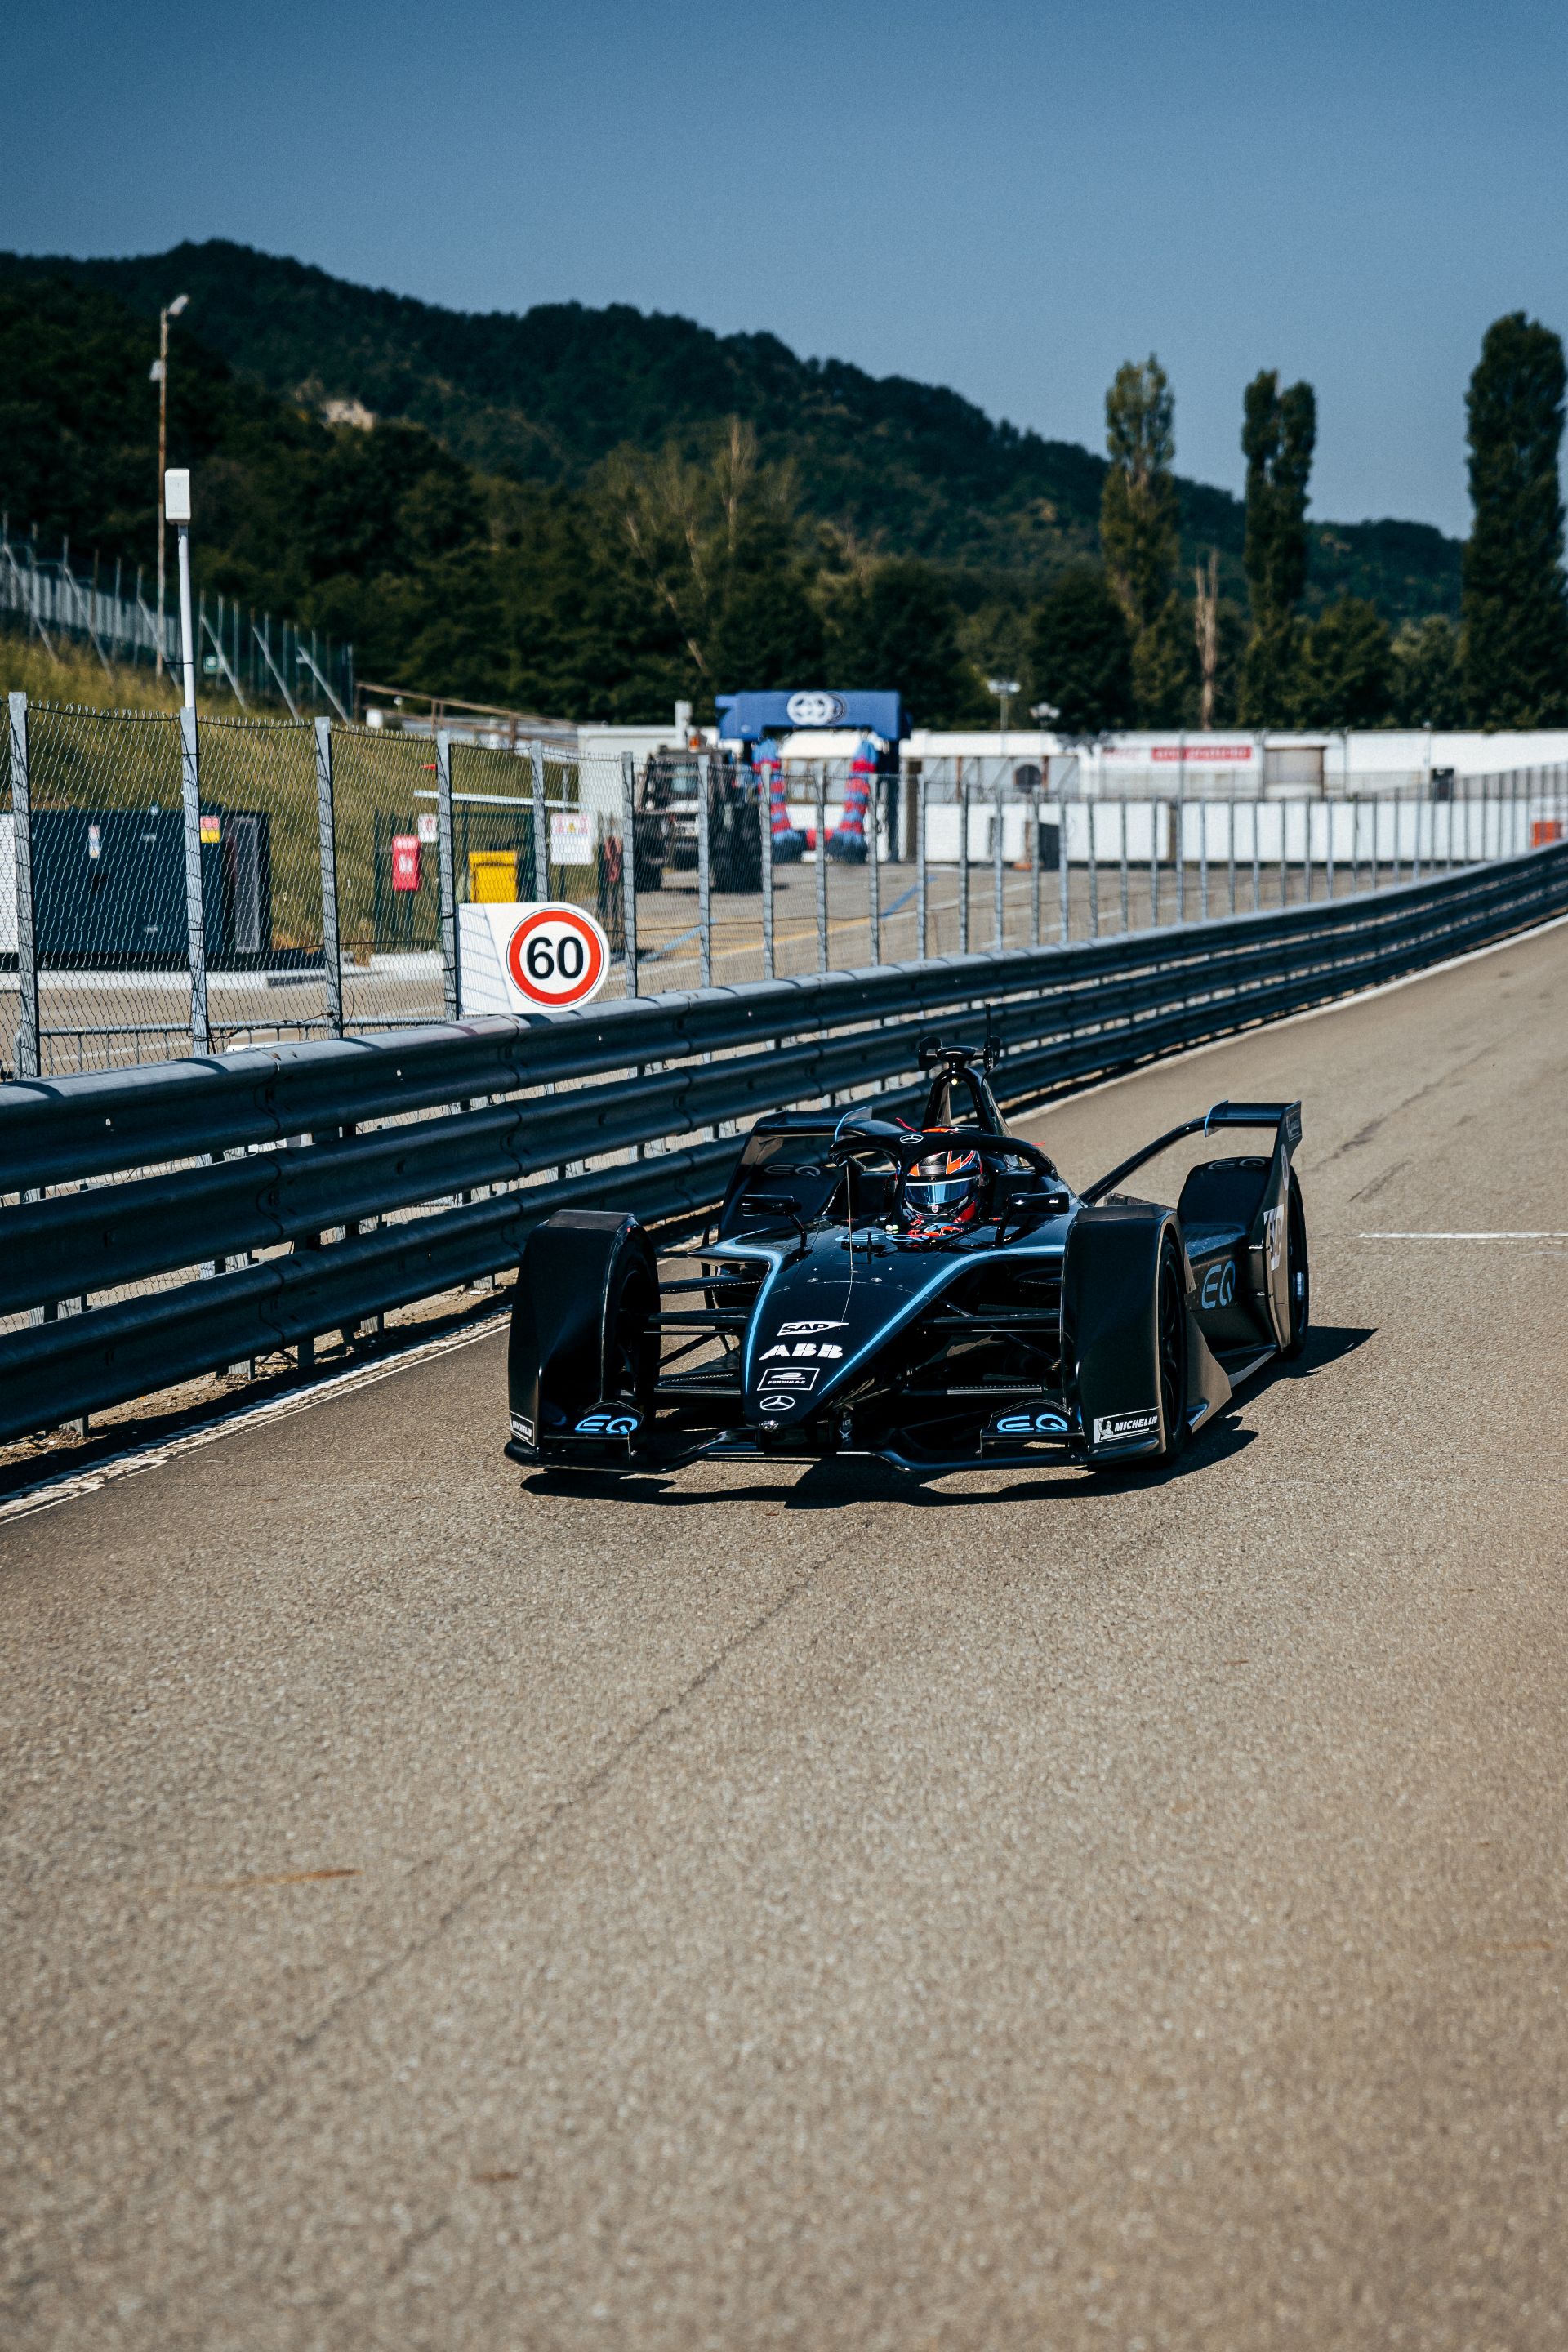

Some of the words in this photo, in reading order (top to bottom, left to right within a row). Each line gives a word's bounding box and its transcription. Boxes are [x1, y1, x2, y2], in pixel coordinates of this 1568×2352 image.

[527, 936, 584, 979] 60
[764, 1165, 821, 1177] EQ
[1207, 1157, 1266, 1170] EQ
[1201, 1260, 1236, 1310] EQ
[759, 1343, 844, 1360] ABB
[574, 1414, 639, 1433] EQ
[996, 1414, 1069, 1432] EQ
[1114, 1414, 1159, 1432] MICHELIN
